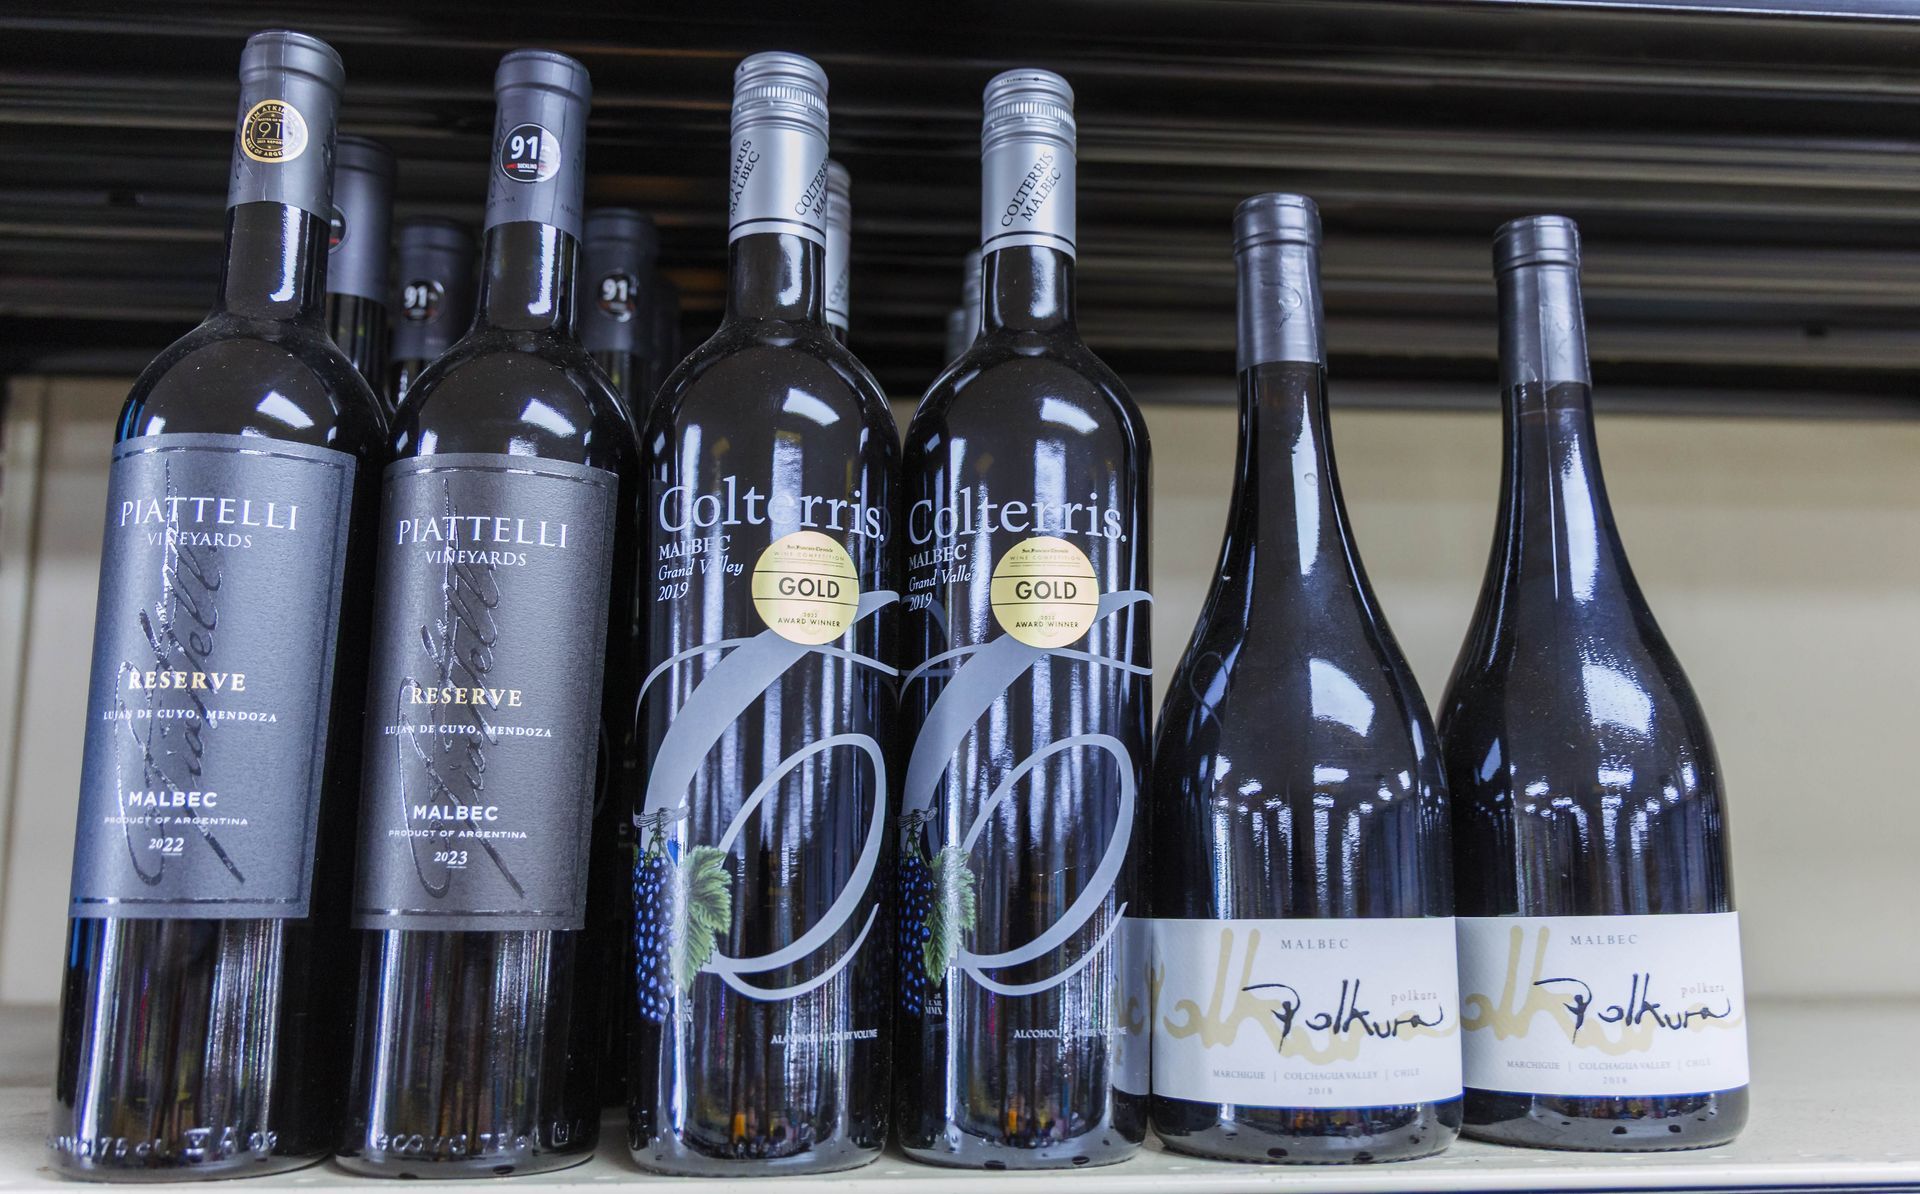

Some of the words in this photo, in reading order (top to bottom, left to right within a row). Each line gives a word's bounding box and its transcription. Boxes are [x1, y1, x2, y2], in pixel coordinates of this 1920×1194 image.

[258, 121, 281, 139] 91
[511, 135, 539, 160] 91
[731, 150, 760, 216] MALBEC
[794, 157, 829, 216] COLTERR
[1001, 150, 1054, 227] COLTERRIS
[1021, 167, 1062, 222] MALBEC
[404, 285, 428, 309] 91
[602, 278, 628, 302] 91
[120, 496, 299, 531] PIATTELLI
[147, 531, 253, 549] VINEYARDS
[397, 516, 569, 549] PIATTELLI
[425, 550, 528, 567] VINEYARDS
[658, 558, 696, 581] Grand
[699, 554, 744, 577] Vlley
[908, 543, 968, 571] MALBEC
[778, 576, 840, 600] GOLD
[908, 568, 937, 592] Grand
[941, 564, 972, 585] Valle
[657, 581, 689, 602] 2019
[1015, 580, 1077, 600] GOLD
[908, 591, 933, 612] 2019
[777, 617, 807, 625] AWARD
[810, 619, 841, 627] WINNER
[128, 670, 247, 692] RESERVE
[410, 687, 523, 708] RESERVE
[103, 709, 133, 721] LUJAN
[137, 708, 152, 719] DE
[156, 708, 200, 720] CUYO,
[206, 710, 278, 723] MENDOZA
[384, 725, 416, 736] LUJAN
[419, 724, 435, 734] DE
[439, 724, 481, 736] CUYO,
[486, 725, 553, 738] MENDOZA
[128, 791, 218, 807] MALBEC
[103, 816, 151, 825] PRODUCT
[154, 816, 171, 824] OF
[174, 816, 249, 825] ARGENTINA
[413, 804, 499, 821] MALBEC
[148, 837, 184, 853] 2022
[388, 830, 436, 838] PRODUCT
[458, 830, 528, 839] ARGENTINA
[434, 850, 468, 865] 2023
[1280, 938, 1350, 950] MALBEC
[1569, 934, 1639, 946] MALBEC
[1241, 978, 1444, 1054] Polkura
[1533, 972, 1731, 1044] Polkura
[1013, 1029, 1061, 1039] ALCOHOL
[1213, 1069, 1265, 1080] MARCHIGUE
[1283, 1071, 1345, 1081] COLCHAGUA
[1345, 1071, 1378, 1080] VALLEY
[1393, 1067, 1420, 1078] CHILE
[1506, 1060, 1560, 1070] MARCHIGUE
[1578, 1062, 1639, 1071] COLCHAGUA
[1639, 1061, 1671, 1070] VALLEY
[1685, 1059, 1712, 1068] CHILE
